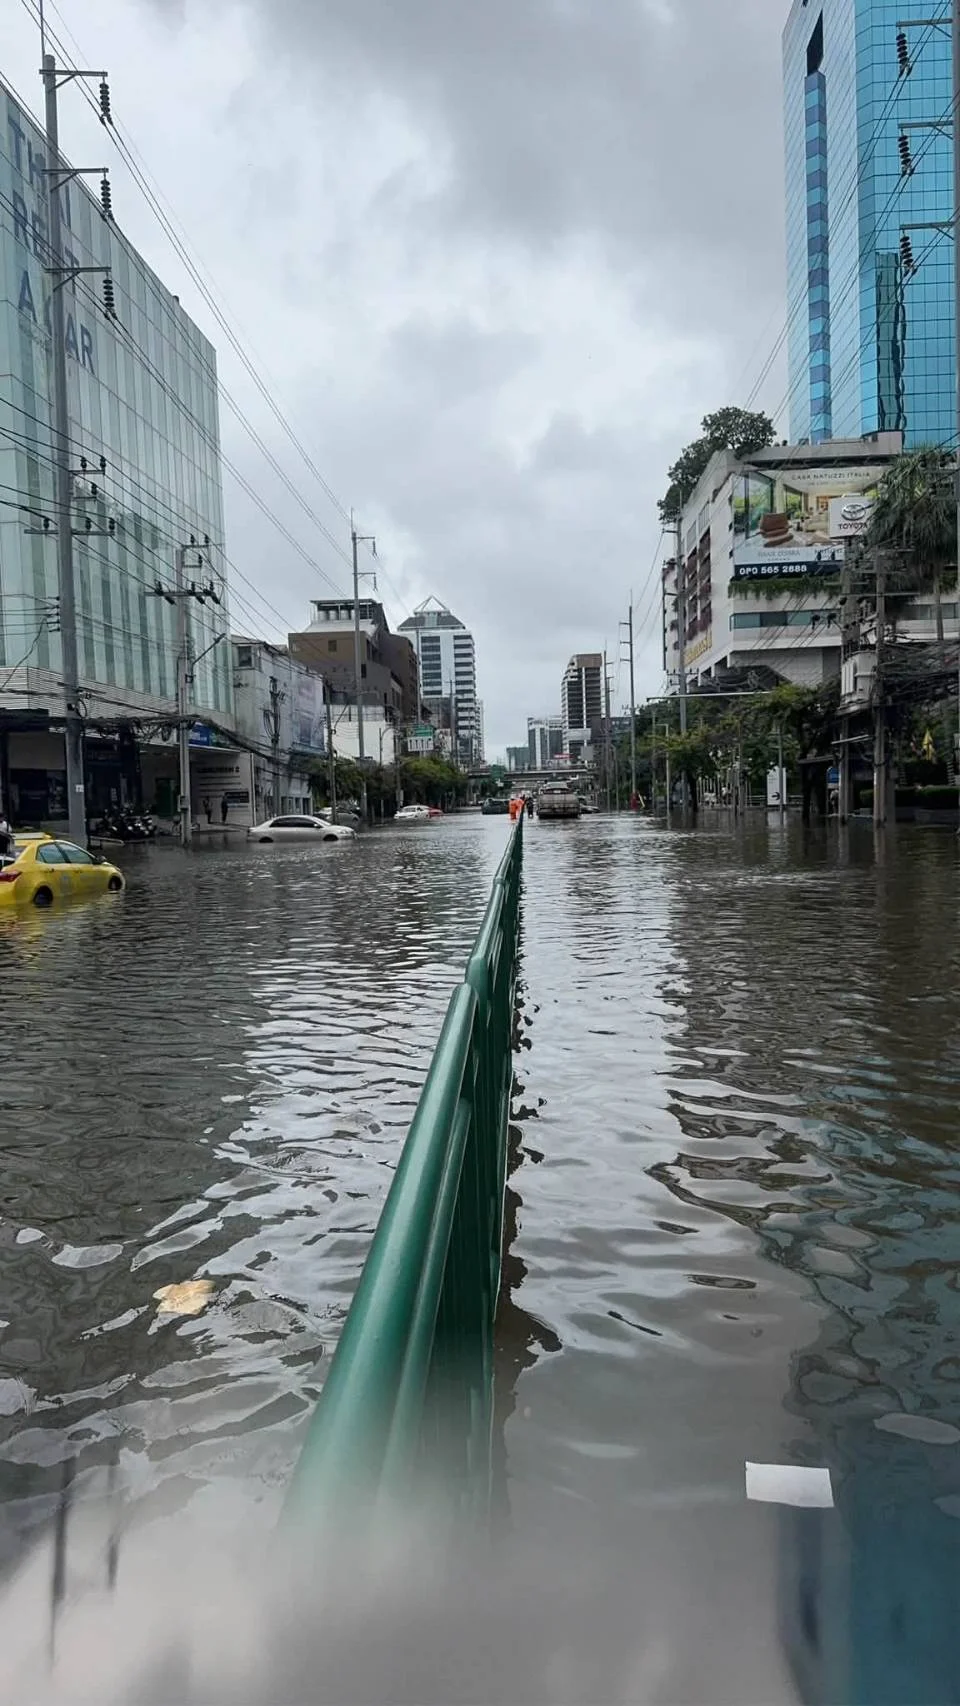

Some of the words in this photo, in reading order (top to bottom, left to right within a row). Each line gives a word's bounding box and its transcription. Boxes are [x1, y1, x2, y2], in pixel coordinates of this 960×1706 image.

[8, 117, 71, 229] THI
[13, 190, 79, 295] RET
[838, 521, 868, 530] TOYOTA
